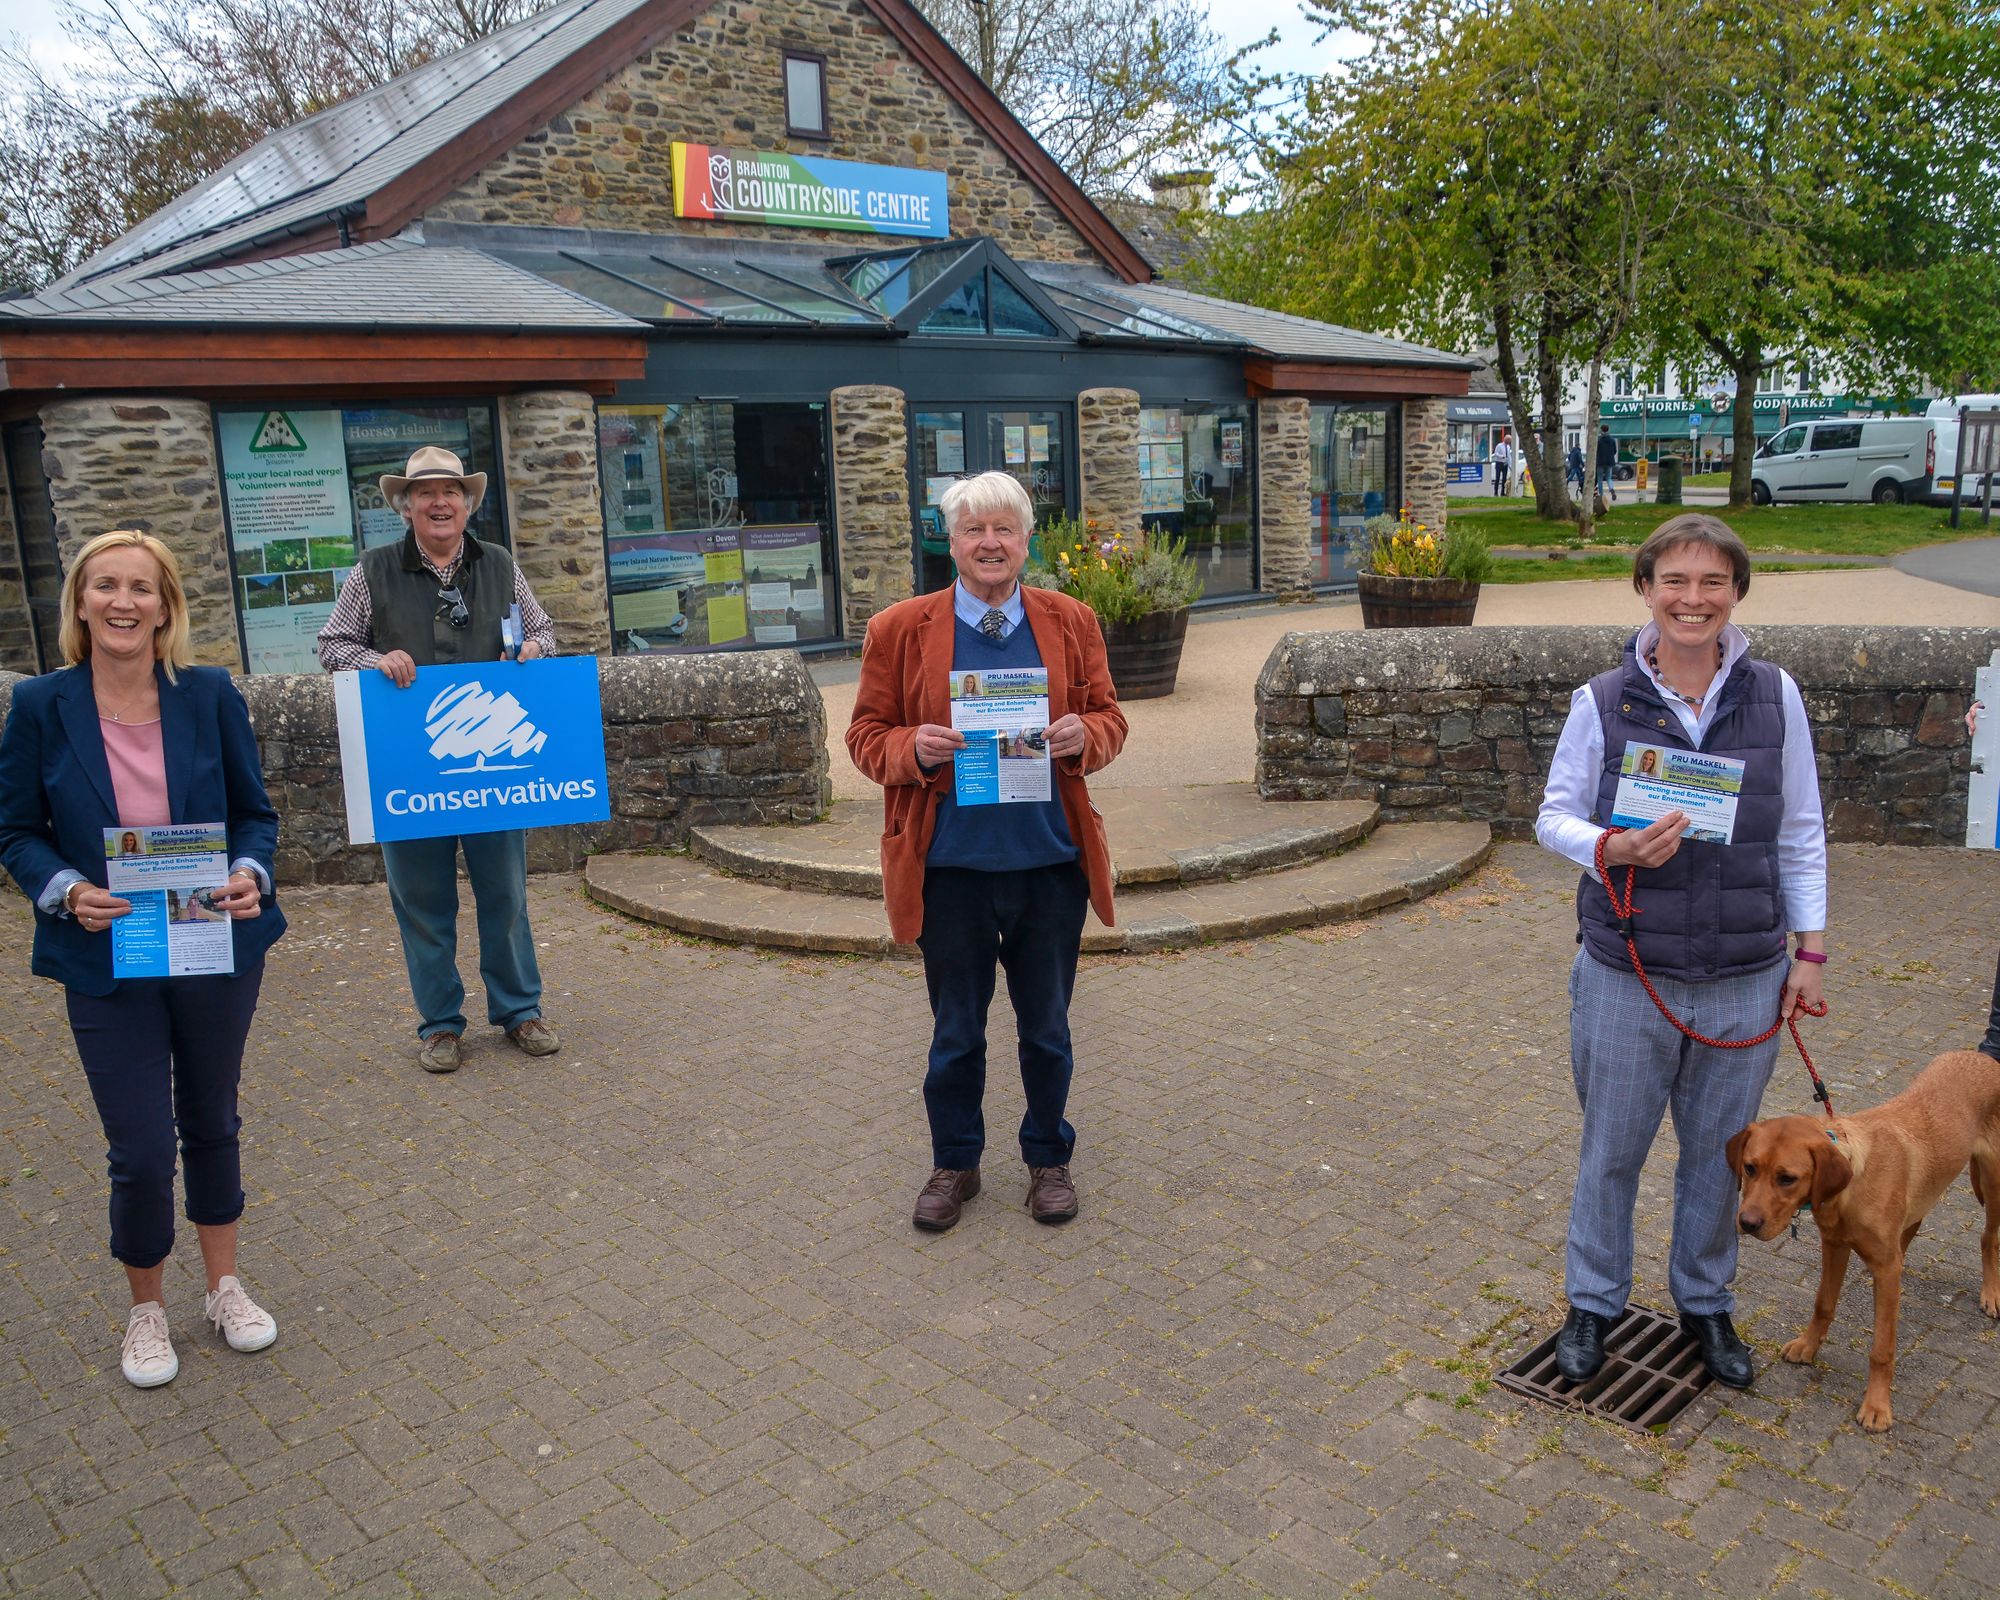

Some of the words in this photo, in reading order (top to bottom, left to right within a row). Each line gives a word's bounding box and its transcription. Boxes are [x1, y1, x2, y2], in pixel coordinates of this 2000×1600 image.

[736, 160, 790, 180] BRAUNTON
[737, 178, 862, 216] COUNTRYSIDE
[867, 190, 931, 222] CENTRE
[1753, 397, 1835, 409] OODMARKET
[349, 425, 398, 439] Horsey
[401, 419, 443, 436] Island
[225, 471, 246, 481] dopt
[247, 471, 268, 480] your
[270, 469, 291, 478] local
[293, 468, 314, 476] road
[314, 467, 343, 476] verge!
[238, 481, 287, 491] Volunteers
[288, 479, 325, 488] wanted!
[715, 534, 736, 543] Devon
[630, 557, 648, 565] Island
[649, 556, 669, 564] Nature
[1671, 754, 1689, 765] PRU
[1690, 757, 1728, 770] MASKELL
[1668, 774, 1701, 784] BRAUNTON
[1702, 779, 1723, 787] RURAL
[385, 777, 597, 816] Conservatives
[1633, 782, 1670, 795] Protecting
[1671, 789, 1685, 797] and
[1686, 791, 1723, 804] Enhancing
[1661, 793, 1706, 807] Environment
[170, 828, 209, 836] MASKELL
[121, 860, 159, 868] Protecting
[176, 856, 213, 864] Enhancing
[152, 864, 198, 872] Environment
